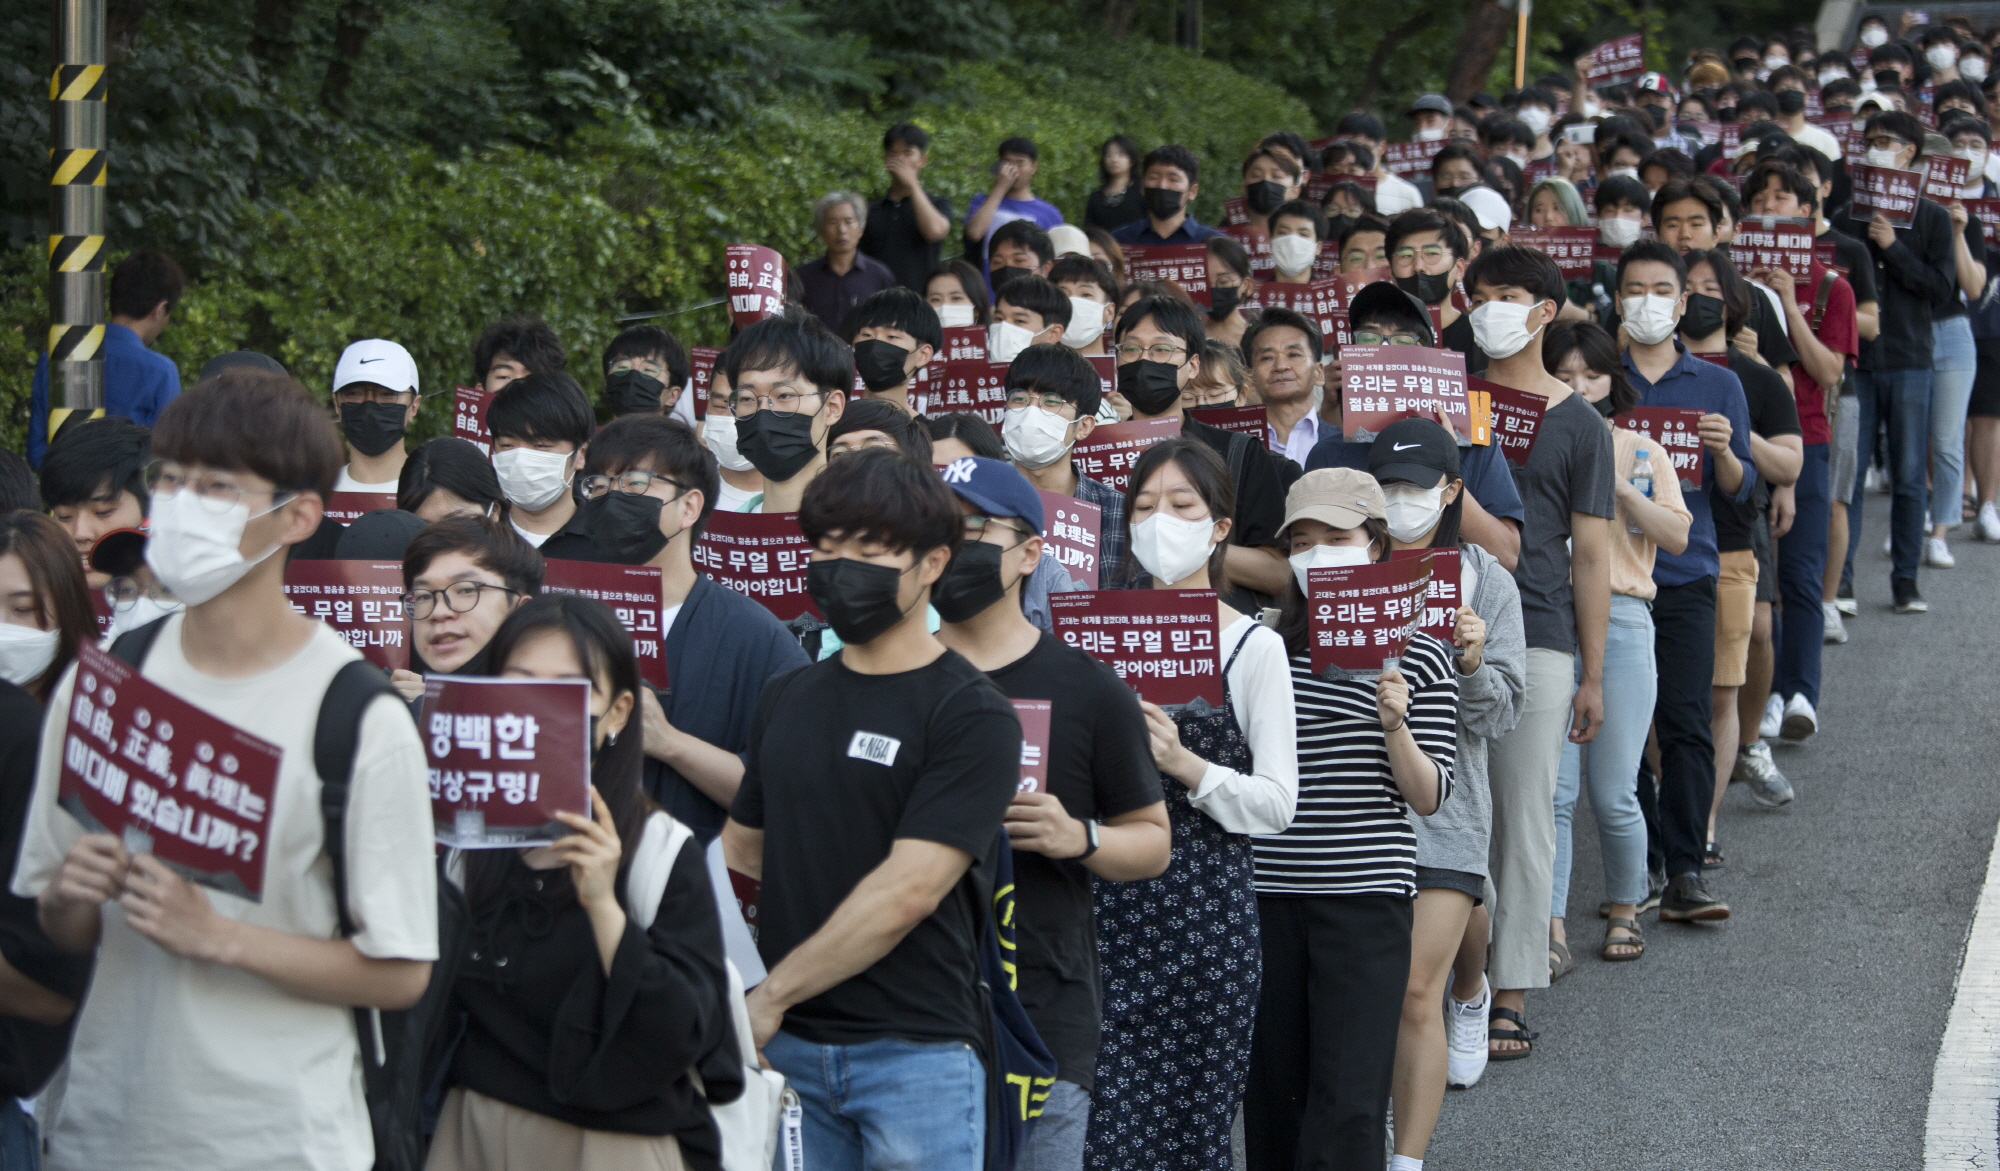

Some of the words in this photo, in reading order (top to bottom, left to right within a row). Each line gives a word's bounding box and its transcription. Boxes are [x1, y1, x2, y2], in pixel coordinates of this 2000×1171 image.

[729, 270, 753, 289] 自由,
[1182, 265, 1205, 279] 믿고
[1346, 364, 1365, 372] 고대는
[1385, 364, 1410, 372] 걸겠다며,
[1411, 365, 1427, 373] 젊음을
[1428, 366, 1442, 374] 걸으라
[1442, 368, 1463, 377] 했습니다.
[1347, 375, 1397, 393] 우리는
[1403, 375, 1434, 394] 무얼
[1437, 378, 1465, 397] 믿고
[1349, 397, 1389, 412] 젊음을
[456, 412, 482, 437] 自由,
[1505, 415, 1536, 435] 믿고
[1661, 431, 1700, 448] 眞理는
[943, 458, 978, 483] NY
[710, 533, 736, 544] 걸겠다며,
[737, 537, 759, 546] 젊음을
[761, 537, 784, 546] 걸으라
[1053, 520, 1096, 548] 眞理는
[693, 545, 723, 570] 리는
[729, 550, 769, 574] 무얼
[293, 585, 322, 594] 걸겠다며,
[324, 585, 345, 594] 젊음을
[348, 585, 370, 594] 걸으라
[372, 585, 404, 594] 했습니다.
[602, 591, 622, 601] 걸으라
[624, 592, 657, 603] 했습니다.
[1314, 591, 1337, 599] 고대는
[1338, 589, 1360, 598] 세계를
[1362, 586, 1390, 597] 걸겠다며,
[1392, 584, 1408, 594] 젊음을
[313, 600, 353, 623] 무얼
[362, 600, 404, 623] 믿고
[616, 608, 657, 632] 믿고
[1058, 617, 1079, 625] 고대는
[1081, 616, 1101, 625] 세계를
[1103, 615, 1130, 625] 걸겠다며,
[1132, 615, 1153, 625] 젊음을
[1155, 615, 1178, 624] 걸으라
[1180, 614, 1213, 624] 했습니다.
[1315, 602, 1377, 625] 우리는
[1383, 596, 1412, 620] 무얼
[1122, 631, 1162, 653] 무얼
[1171, 630, 1214, 652] 믿고
[1317, 629, 1367, 647] 젊음을
[1113, 659, 1214, 679] 걸어야합니까
[429, 713, 540, 760] 명백한
[73, 693, 118, 754] 自由,
[183, 761, 266, 823] 眞理는
[865, 736, 891, 763] NBA
[428, 768, 541, 805] 진상규명!
[65, 734, 129, 805] 어디에
[130, 779, 260, 862] 있습니까?
